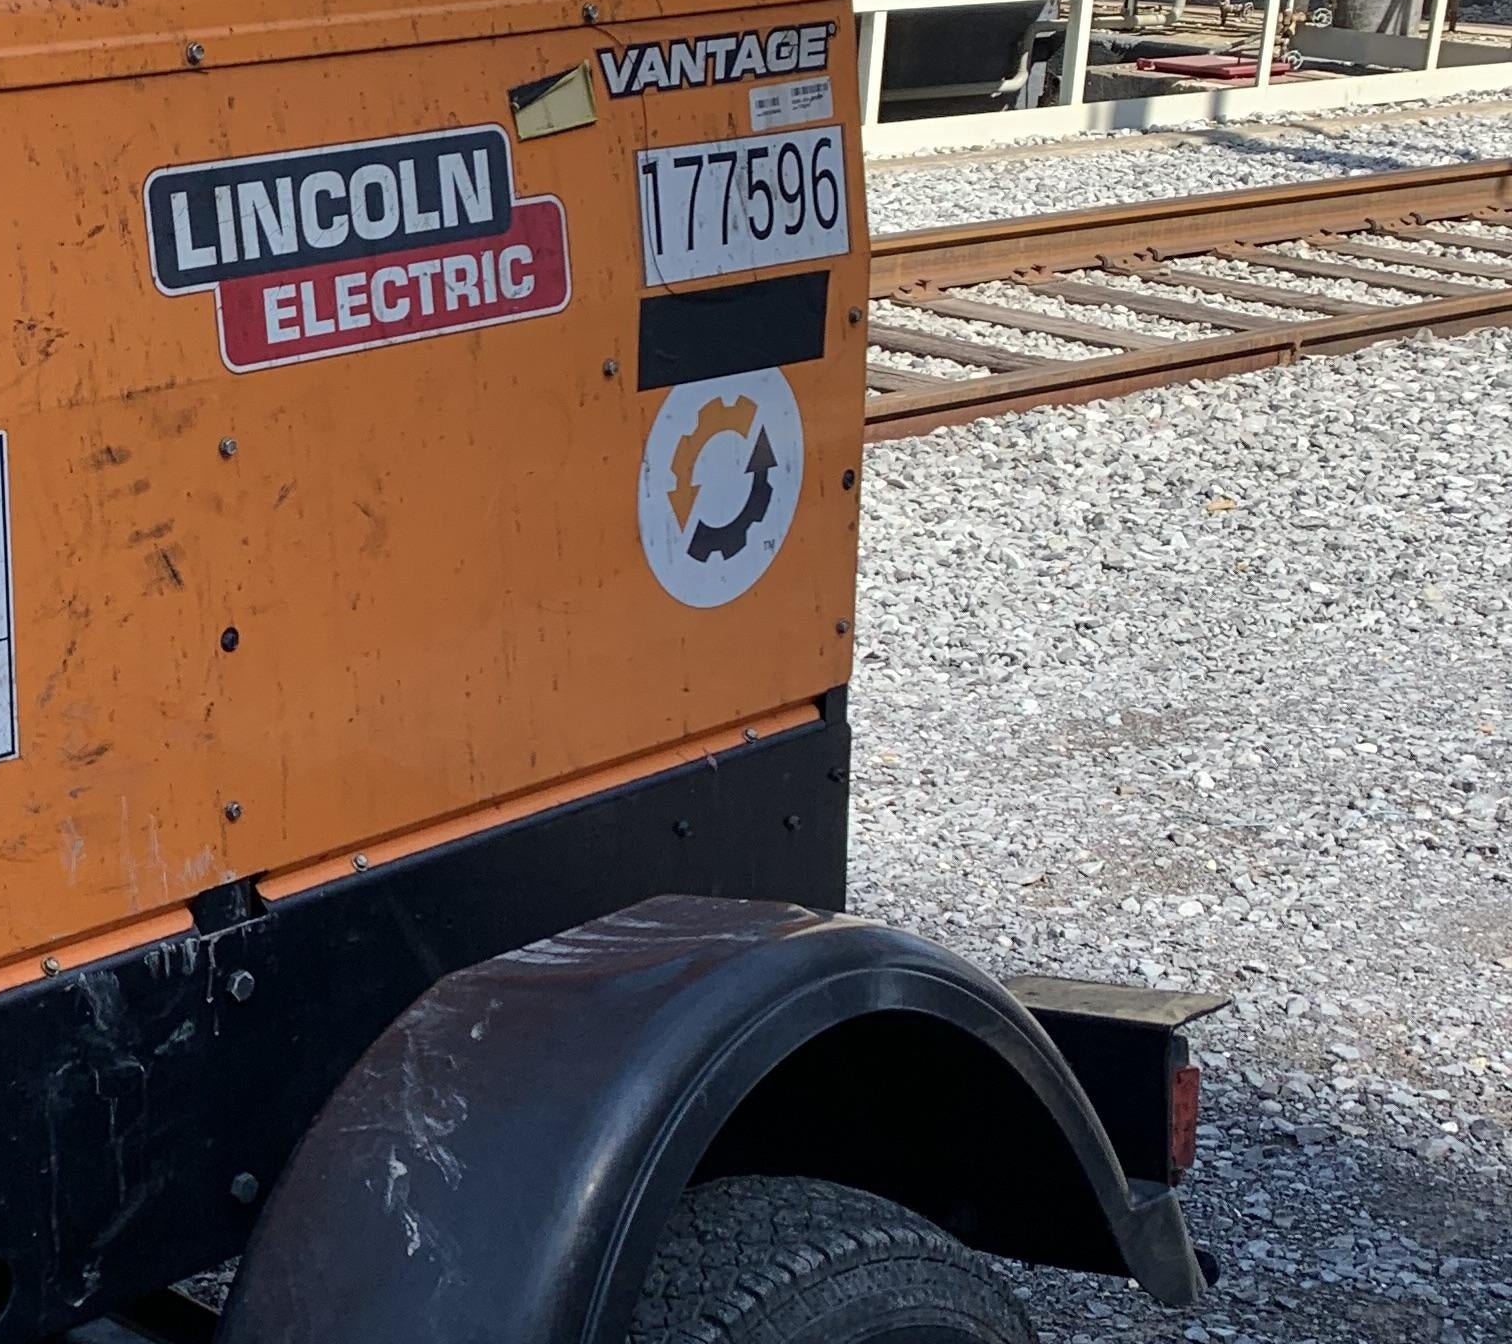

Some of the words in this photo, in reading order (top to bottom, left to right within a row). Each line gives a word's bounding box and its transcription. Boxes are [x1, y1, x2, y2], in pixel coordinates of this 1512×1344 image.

[600, 26, 827, 94] VANTAGE
[171, 148, 494, 271] LINCOLN
[642, 137, 839, 256] 177596
[263, 244, 536, 345] ELECTRIC
